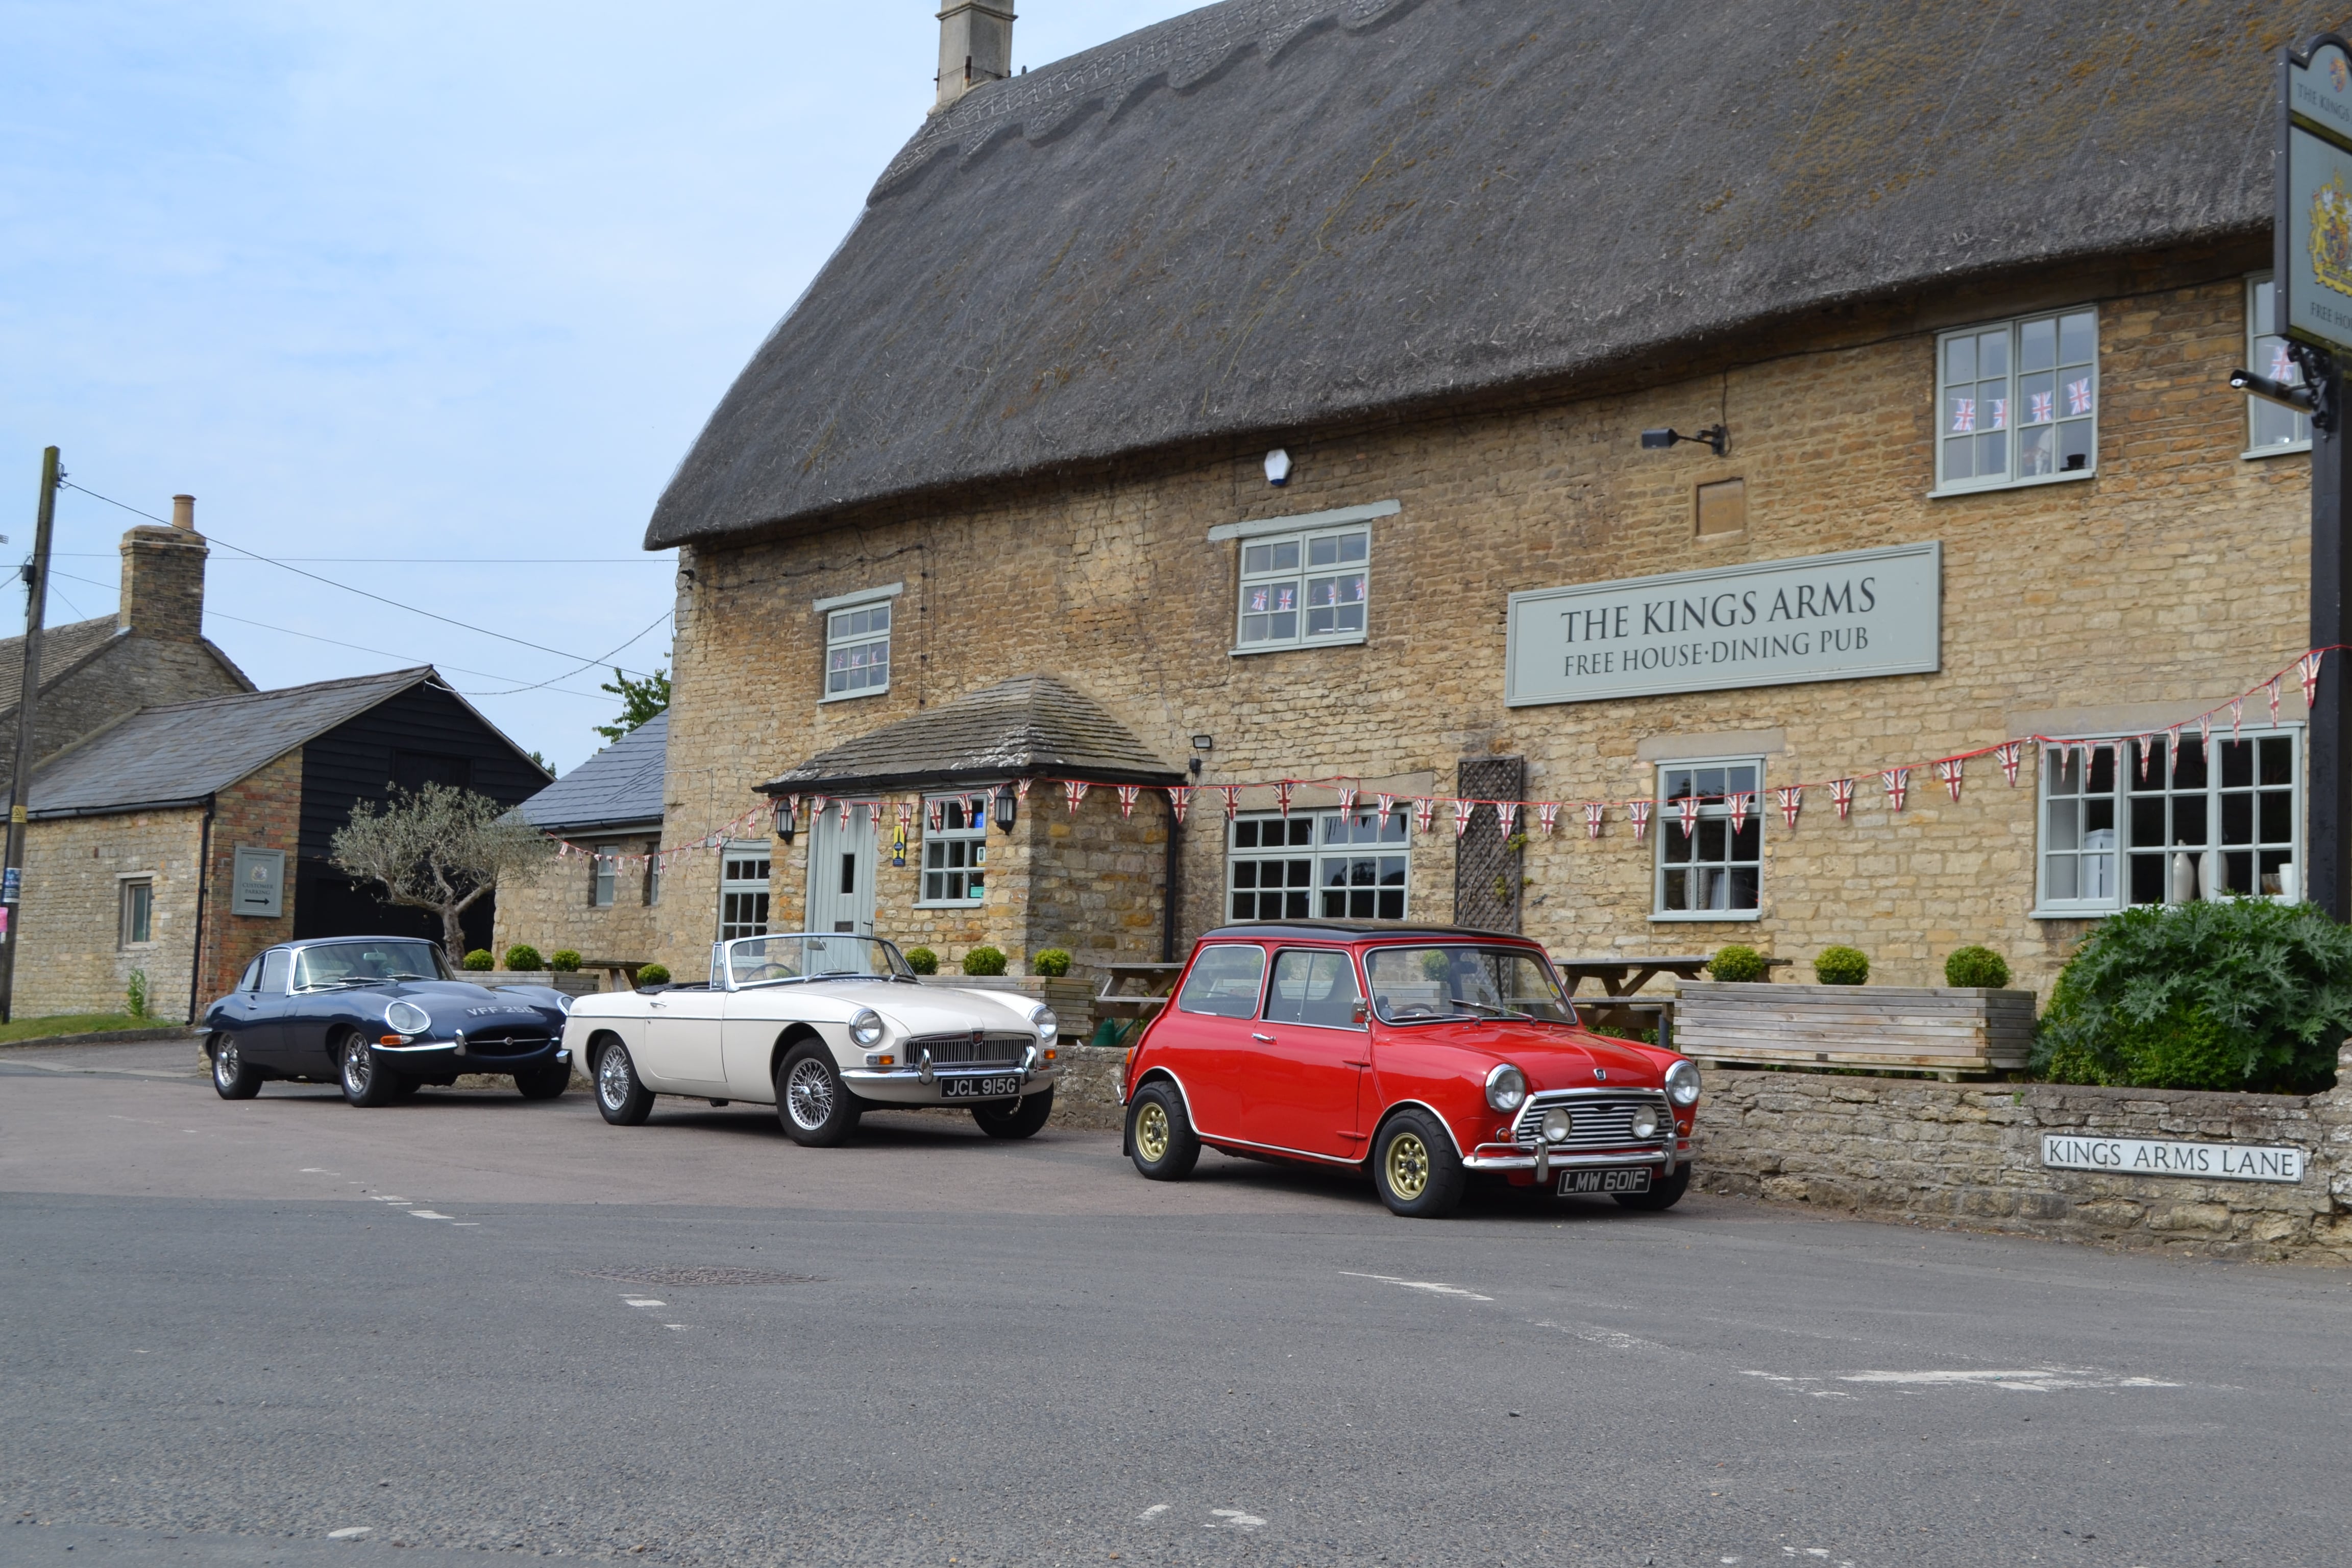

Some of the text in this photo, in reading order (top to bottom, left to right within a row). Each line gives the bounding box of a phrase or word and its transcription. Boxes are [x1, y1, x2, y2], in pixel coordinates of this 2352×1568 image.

[2297, 83, 2350, 122] THE KINGS
[2310, 302, 2352, 333] FREE HO
[1560, 577, 1876, 643] THE KINGS ARMS
[1564, 652, 1614, 676] FREE
[1819, 627, 1868, 653] PUB
[467, 1007, 498, 1016] VFF
[947, 1078, 1016, 1096] JCL 915G
[2049, 1140, 2295, 1177] KINGS ARMS LANE
[1564, 1171, 1646, 1192] LMW 601F
